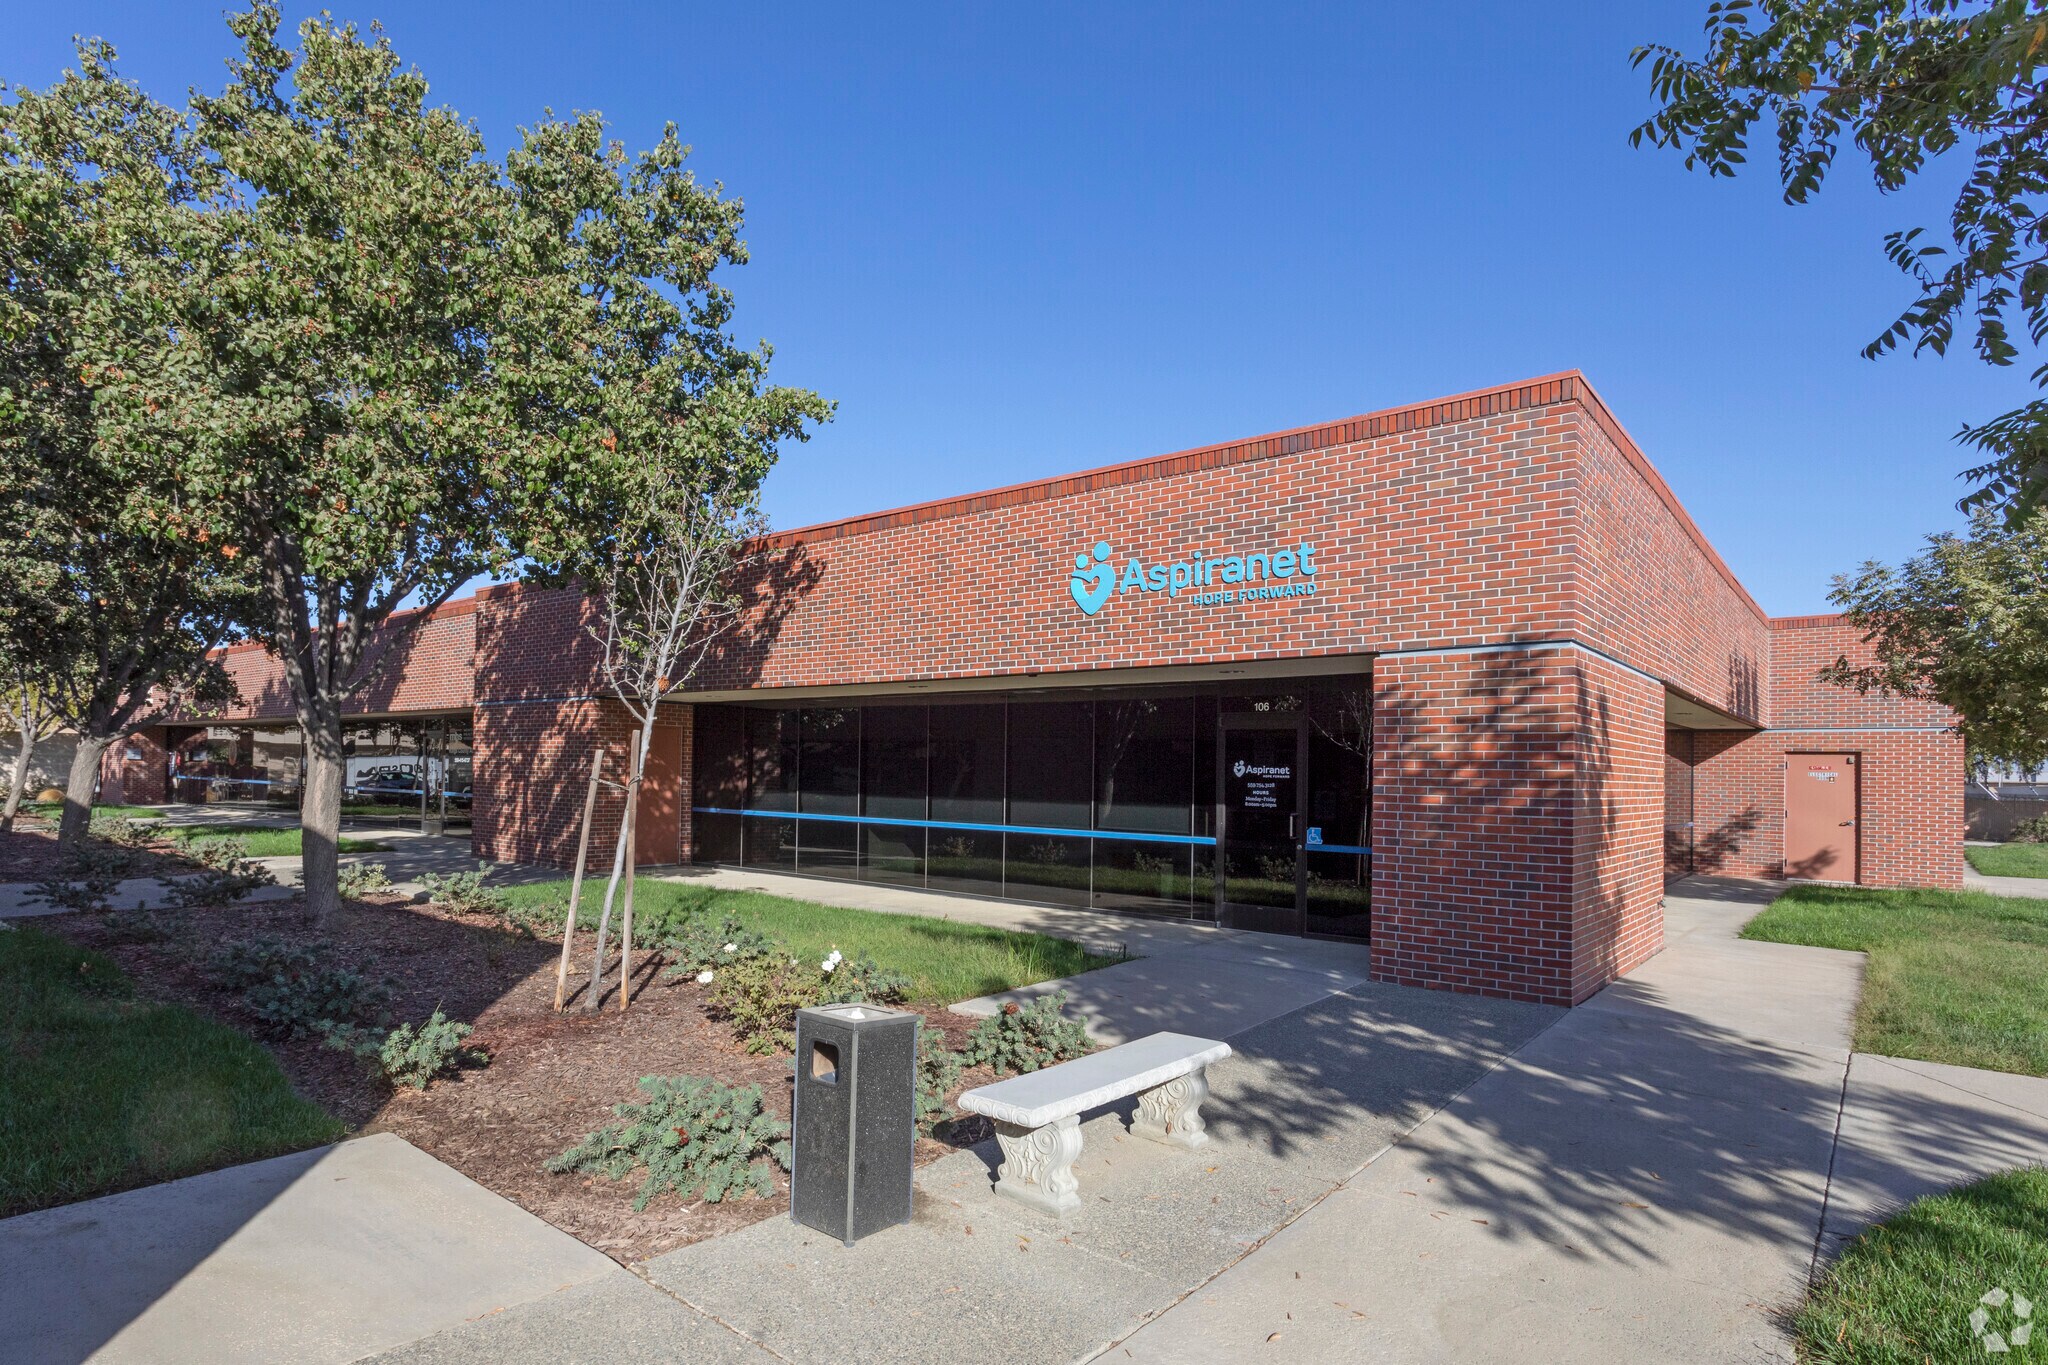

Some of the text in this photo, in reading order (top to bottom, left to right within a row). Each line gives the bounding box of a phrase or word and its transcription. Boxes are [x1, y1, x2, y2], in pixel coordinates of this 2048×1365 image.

[1119, 542, 1318, 598] Aspiranet
[1193, 583, 1318, 606] HOPE FORWARD
[1254, 702, 1269, 711] 106
[1246, 766, 1290, 775] Aspiranet
